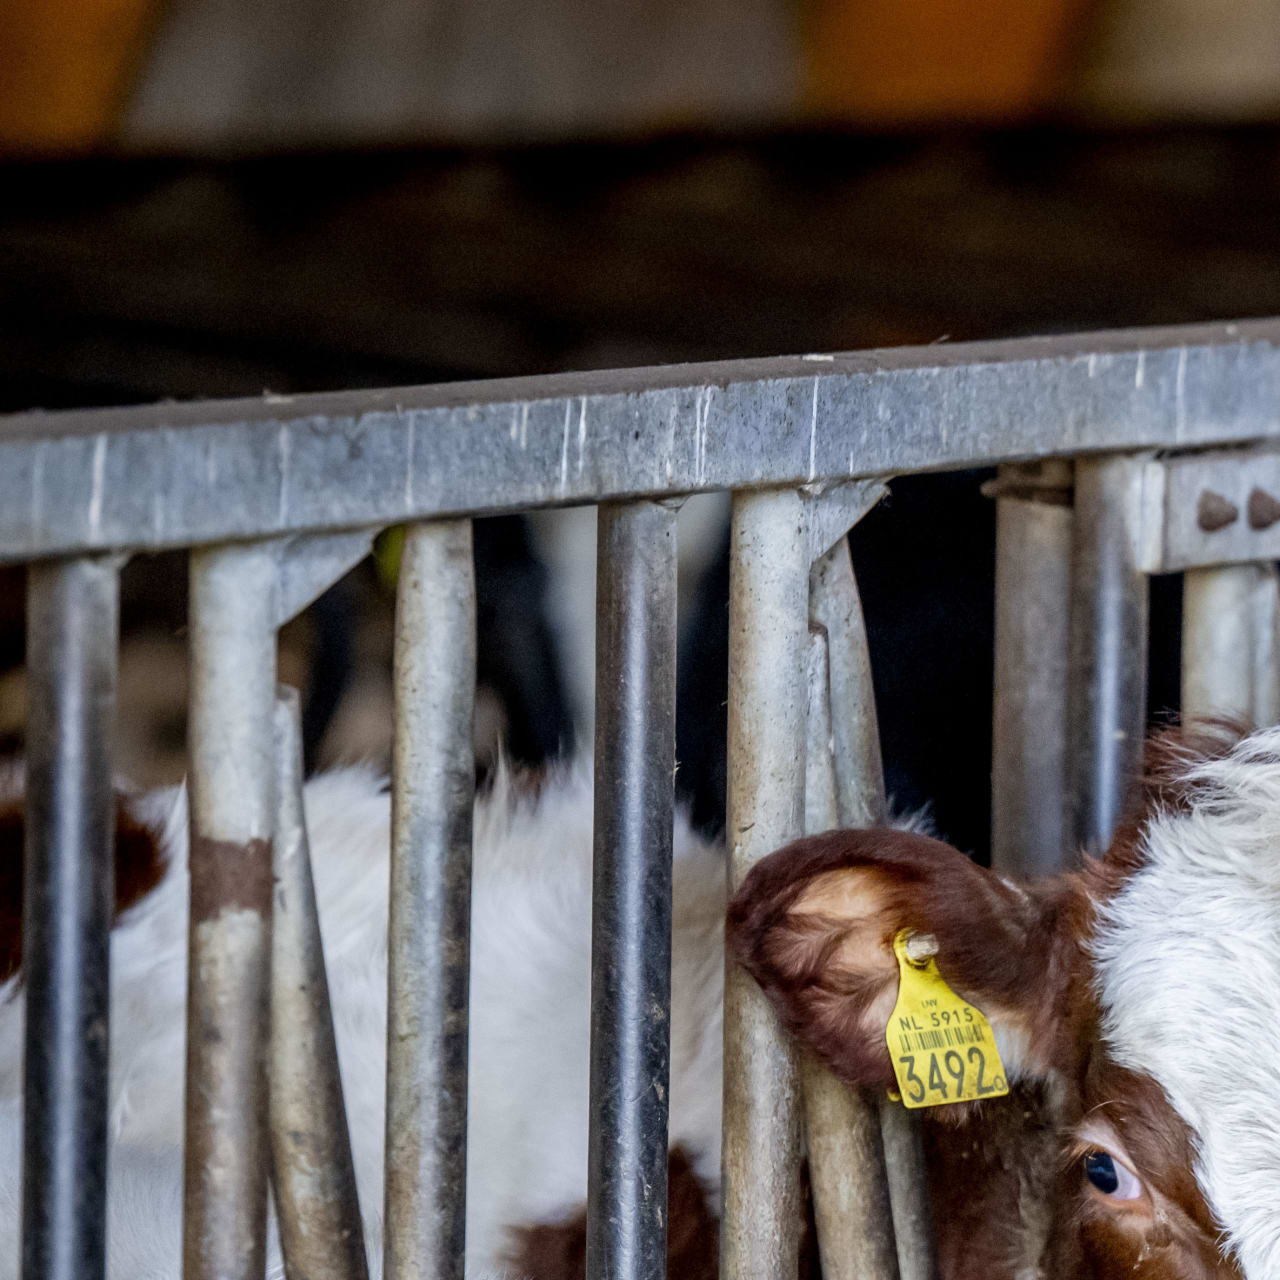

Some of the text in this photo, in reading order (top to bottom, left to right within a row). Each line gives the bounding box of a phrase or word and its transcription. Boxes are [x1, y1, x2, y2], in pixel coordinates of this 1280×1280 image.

[900, 1008, 974, 1031] NL 5915
[900, 1047, 994, 1103] 3492
